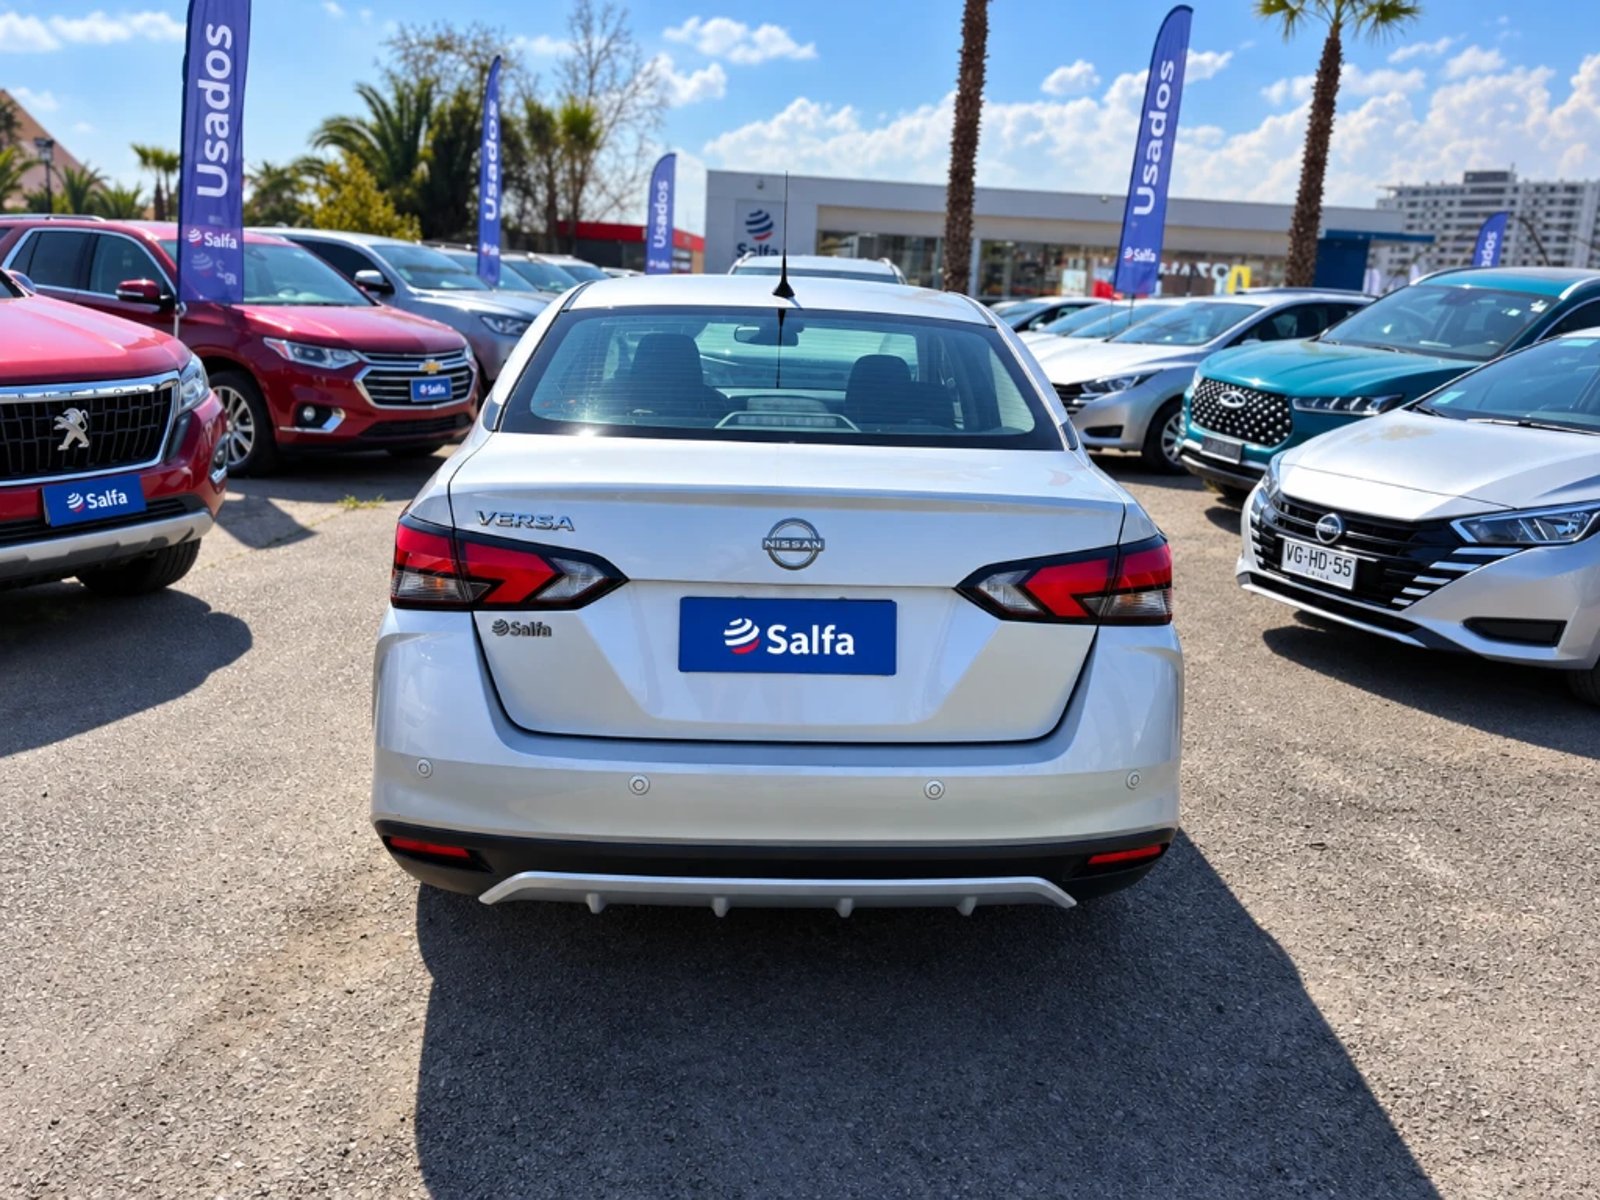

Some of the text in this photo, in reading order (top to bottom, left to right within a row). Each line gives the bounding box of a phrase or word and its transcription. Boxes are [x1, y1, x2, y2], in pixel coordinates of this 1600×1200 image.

[196, 23, 233, 198] Usados
[1133, 60, 1175, 216] Usados
[484, 99, 498, 221] Usados
[653, 180, 669, 249] Usados
[204, 231, 238, 250] Salfa
[1480, 231, 1498, 267] ados
[1133, 248, 1157, 263] Salfa
[86, 488, 129, 510] Salfa
[475, 510, 576, 532] VERSA
[764, 539, 822, 550] NISSAN
[510, 621, 553, 638] Salfa
[766, 623, 856, 656] Salfa
